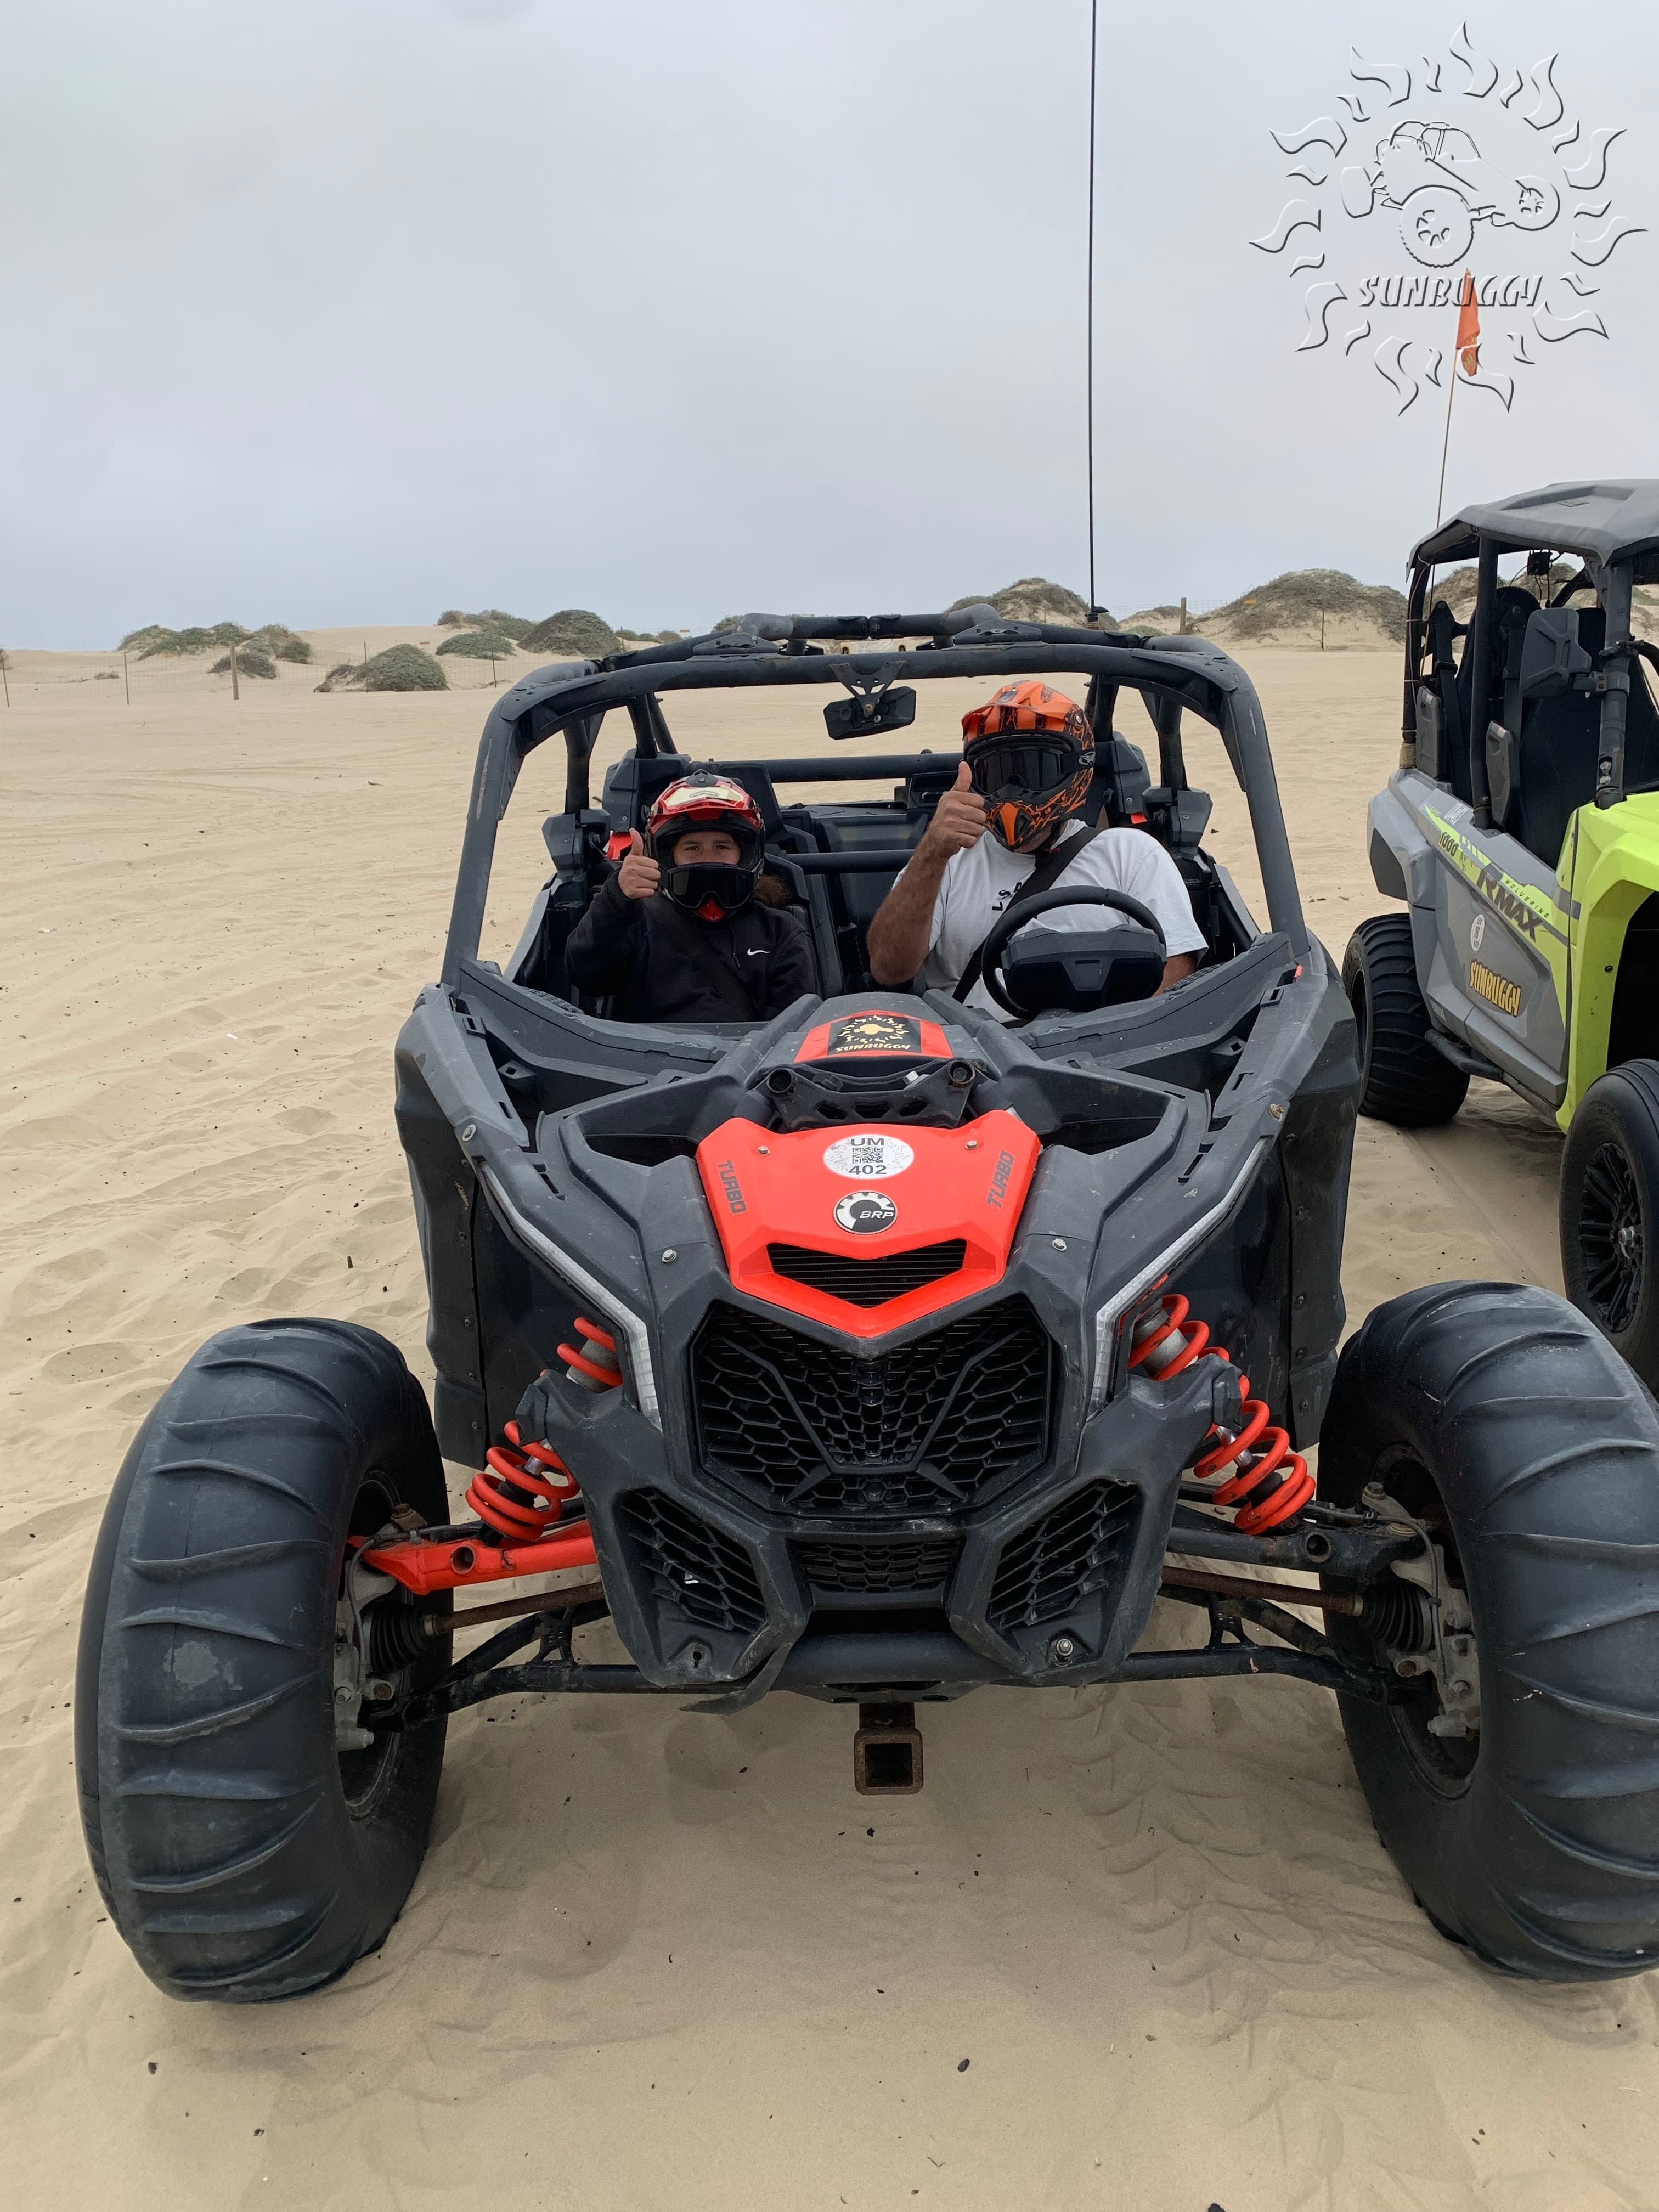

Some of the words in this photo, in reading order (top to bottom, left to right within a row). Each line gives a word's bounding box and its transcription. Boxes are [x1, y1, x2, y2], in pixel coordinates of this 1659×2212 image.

[1439, 832, 1459, 857] 1000
[1476, 869, 1544, 943] RMAX
[1505, 879, 1550, 918] WOLVERINE
[1469, 960, 1522, 1018] SUNBUGGY
[835, 1043, 912, 1052] SUNBUGGY
[851, 1137, 885, 1147] UM
[848, 1165, 887, 1175] 402
[986, 1150, 1014, 1208] TURBO
[717, 1159, 747, 1214] TURBO
[859, 1210, 894, 1219] BRP
